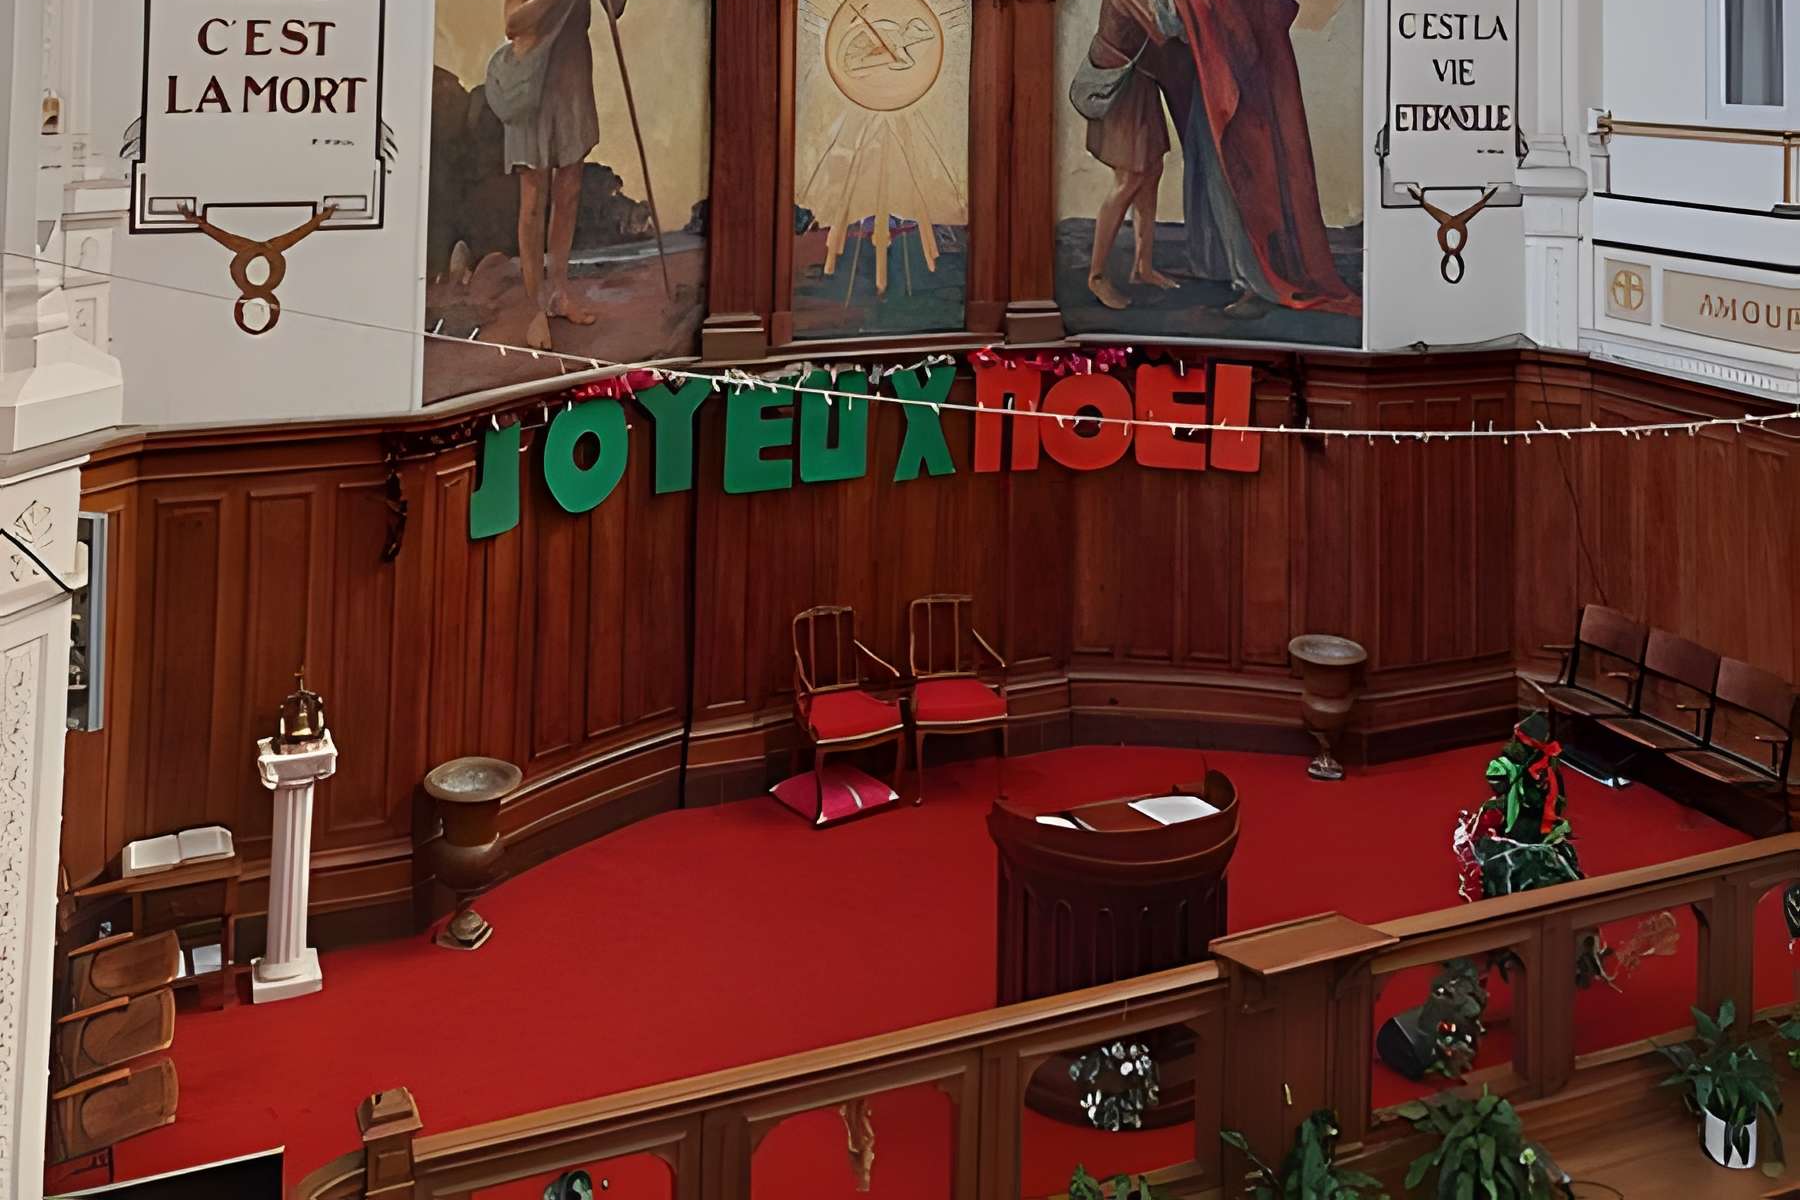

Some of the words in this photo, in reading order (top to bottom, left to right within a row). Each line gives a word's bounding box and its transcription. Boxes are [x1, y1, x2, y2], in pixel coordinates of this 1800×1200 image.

[197, 17, 337, 58] C'EST
[1473, 14, 1509, 41] LA
[1432, 58, 1476, 87] VIE
[164, 74, 233, 115] LA
[242, 75, 368, 115] MORT
[470, 365, 957, 540] JOYEUX
